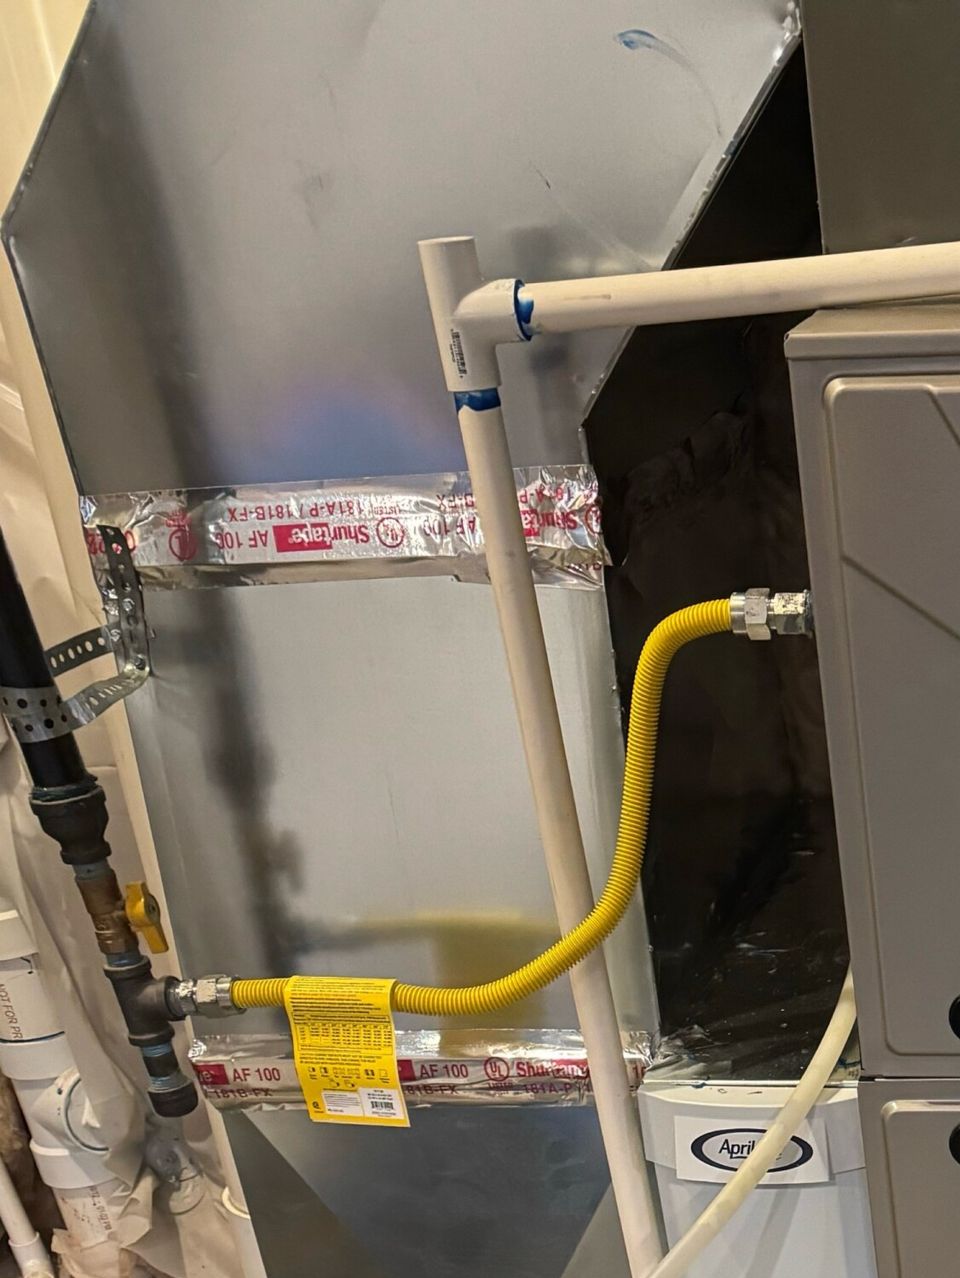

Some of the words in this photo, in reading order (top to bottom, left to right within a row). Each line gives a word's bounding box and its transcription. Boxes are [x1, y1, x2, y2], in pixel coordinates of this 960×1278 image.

[310, 498, 363, 518] 181A-P
[437, 493, 473, 511] B-FX
[228, 504, 292, 522] 181B-FX
[521, 505, 577, 530] Shurta
[249, 530, 267, 548] AF
[2, 1004, 18, 1025] FOR
[233, 1070, 251, 1083] AF
[259, 1068, 281, 1082] 100
[420, 1064, 439, 1078] AF
[443, 1063, 469, 1078] 100
[516, 1062, 588, 1080] Shurta
[405, 1084, 458, 1096] 81B-FX
[523, 1082, 572, 1094] 181A-P
[718, 1139, 756, 1159] April
